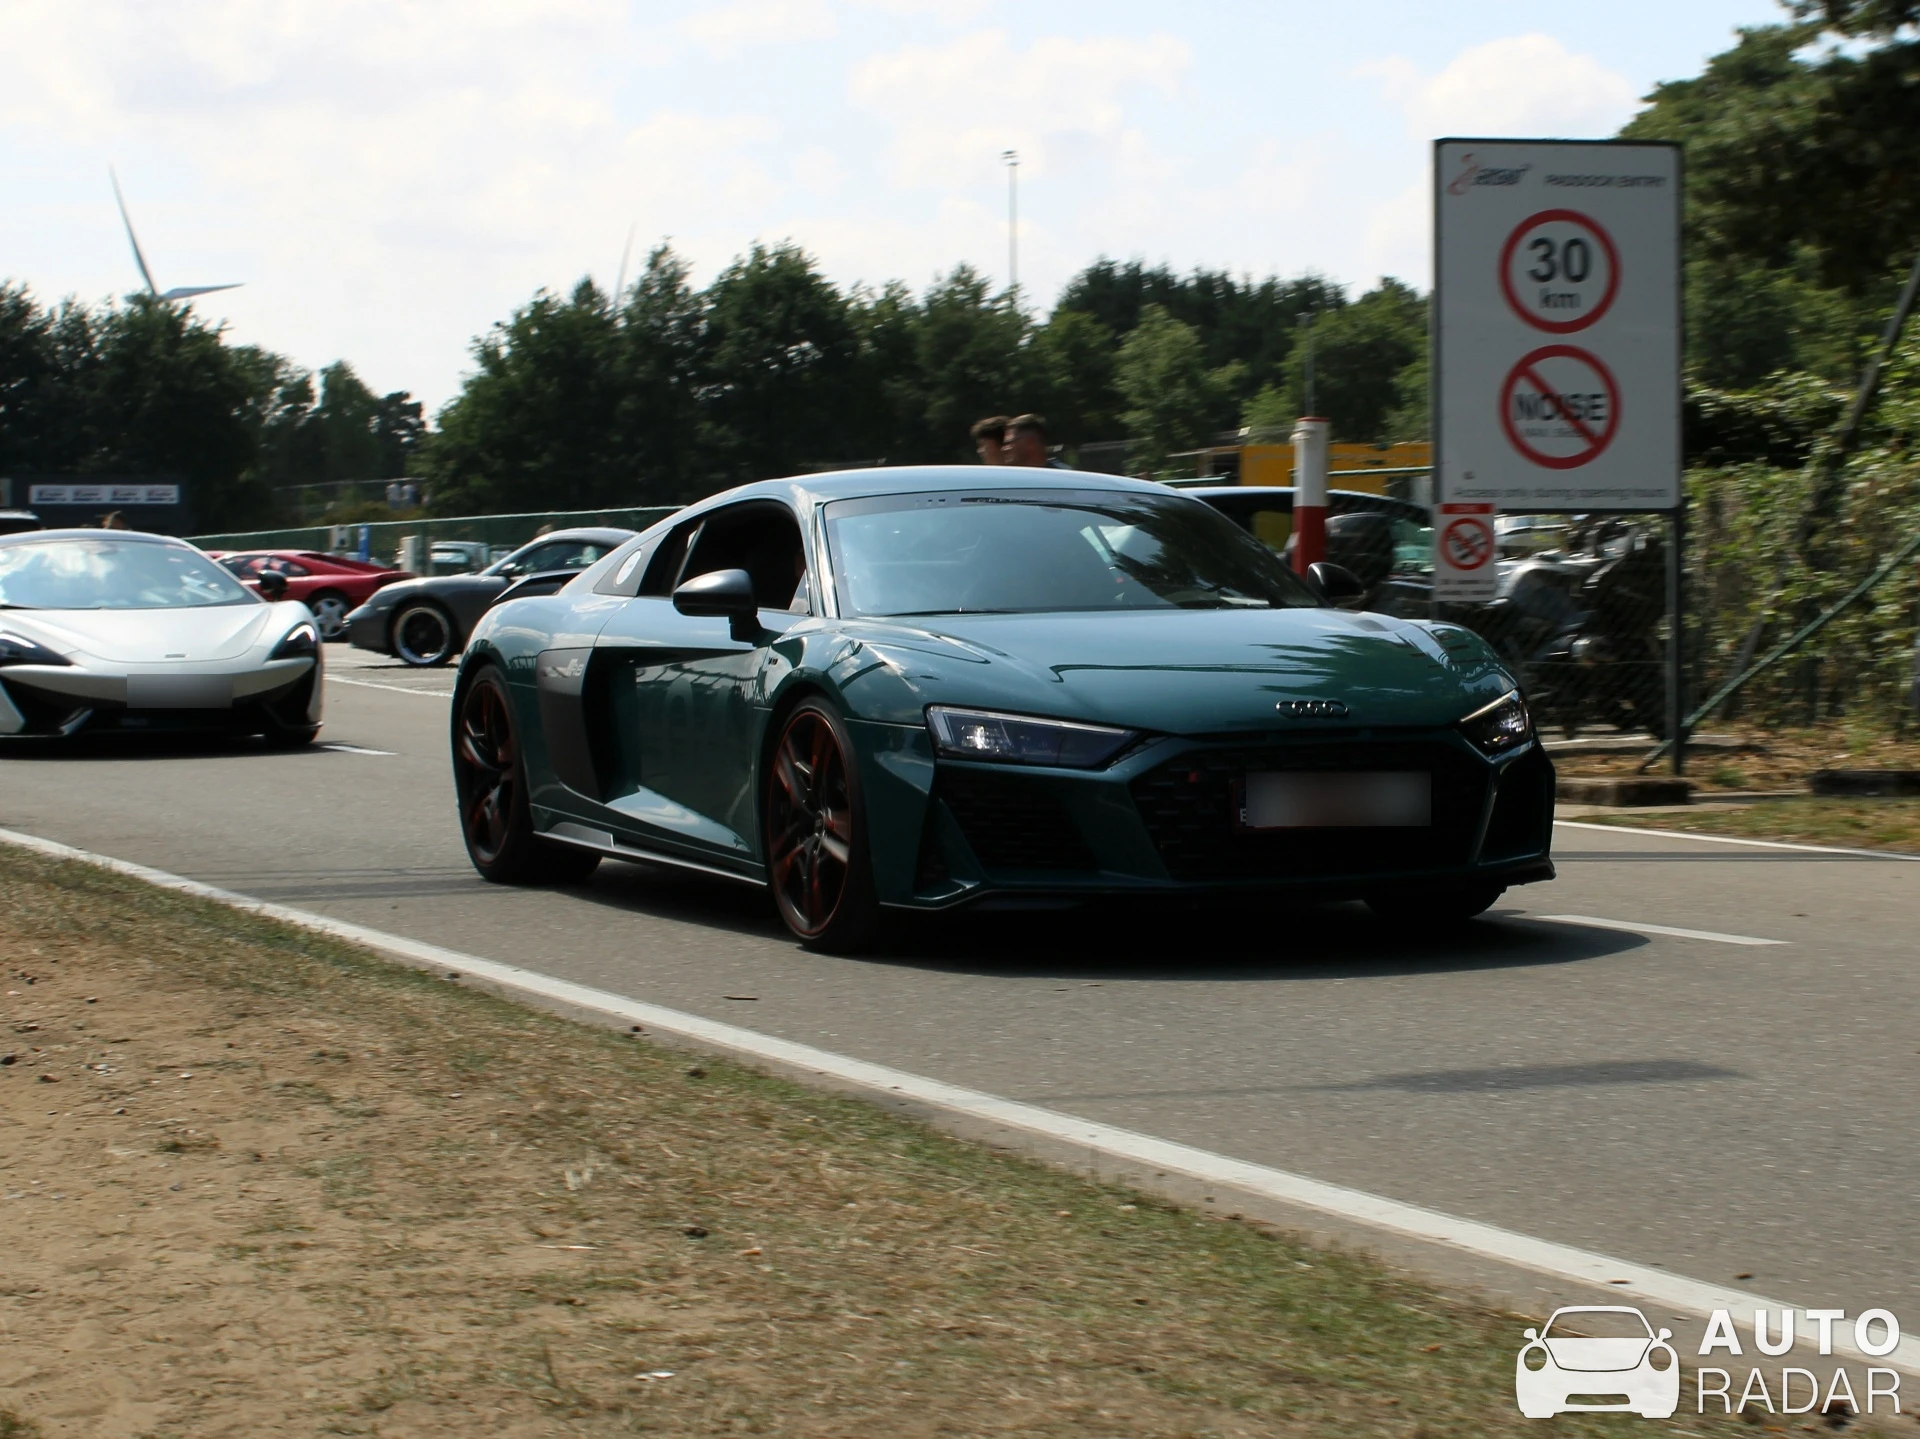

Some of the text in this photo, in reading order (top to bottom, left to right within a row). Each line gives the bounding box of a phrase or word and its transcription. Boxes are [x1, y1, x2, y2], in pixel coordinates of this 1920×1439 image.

[1527, 237, 1592, 283] 30
[1539, 288, 1581, 309] km
[1513, 393, 1609, 421] NOISE
